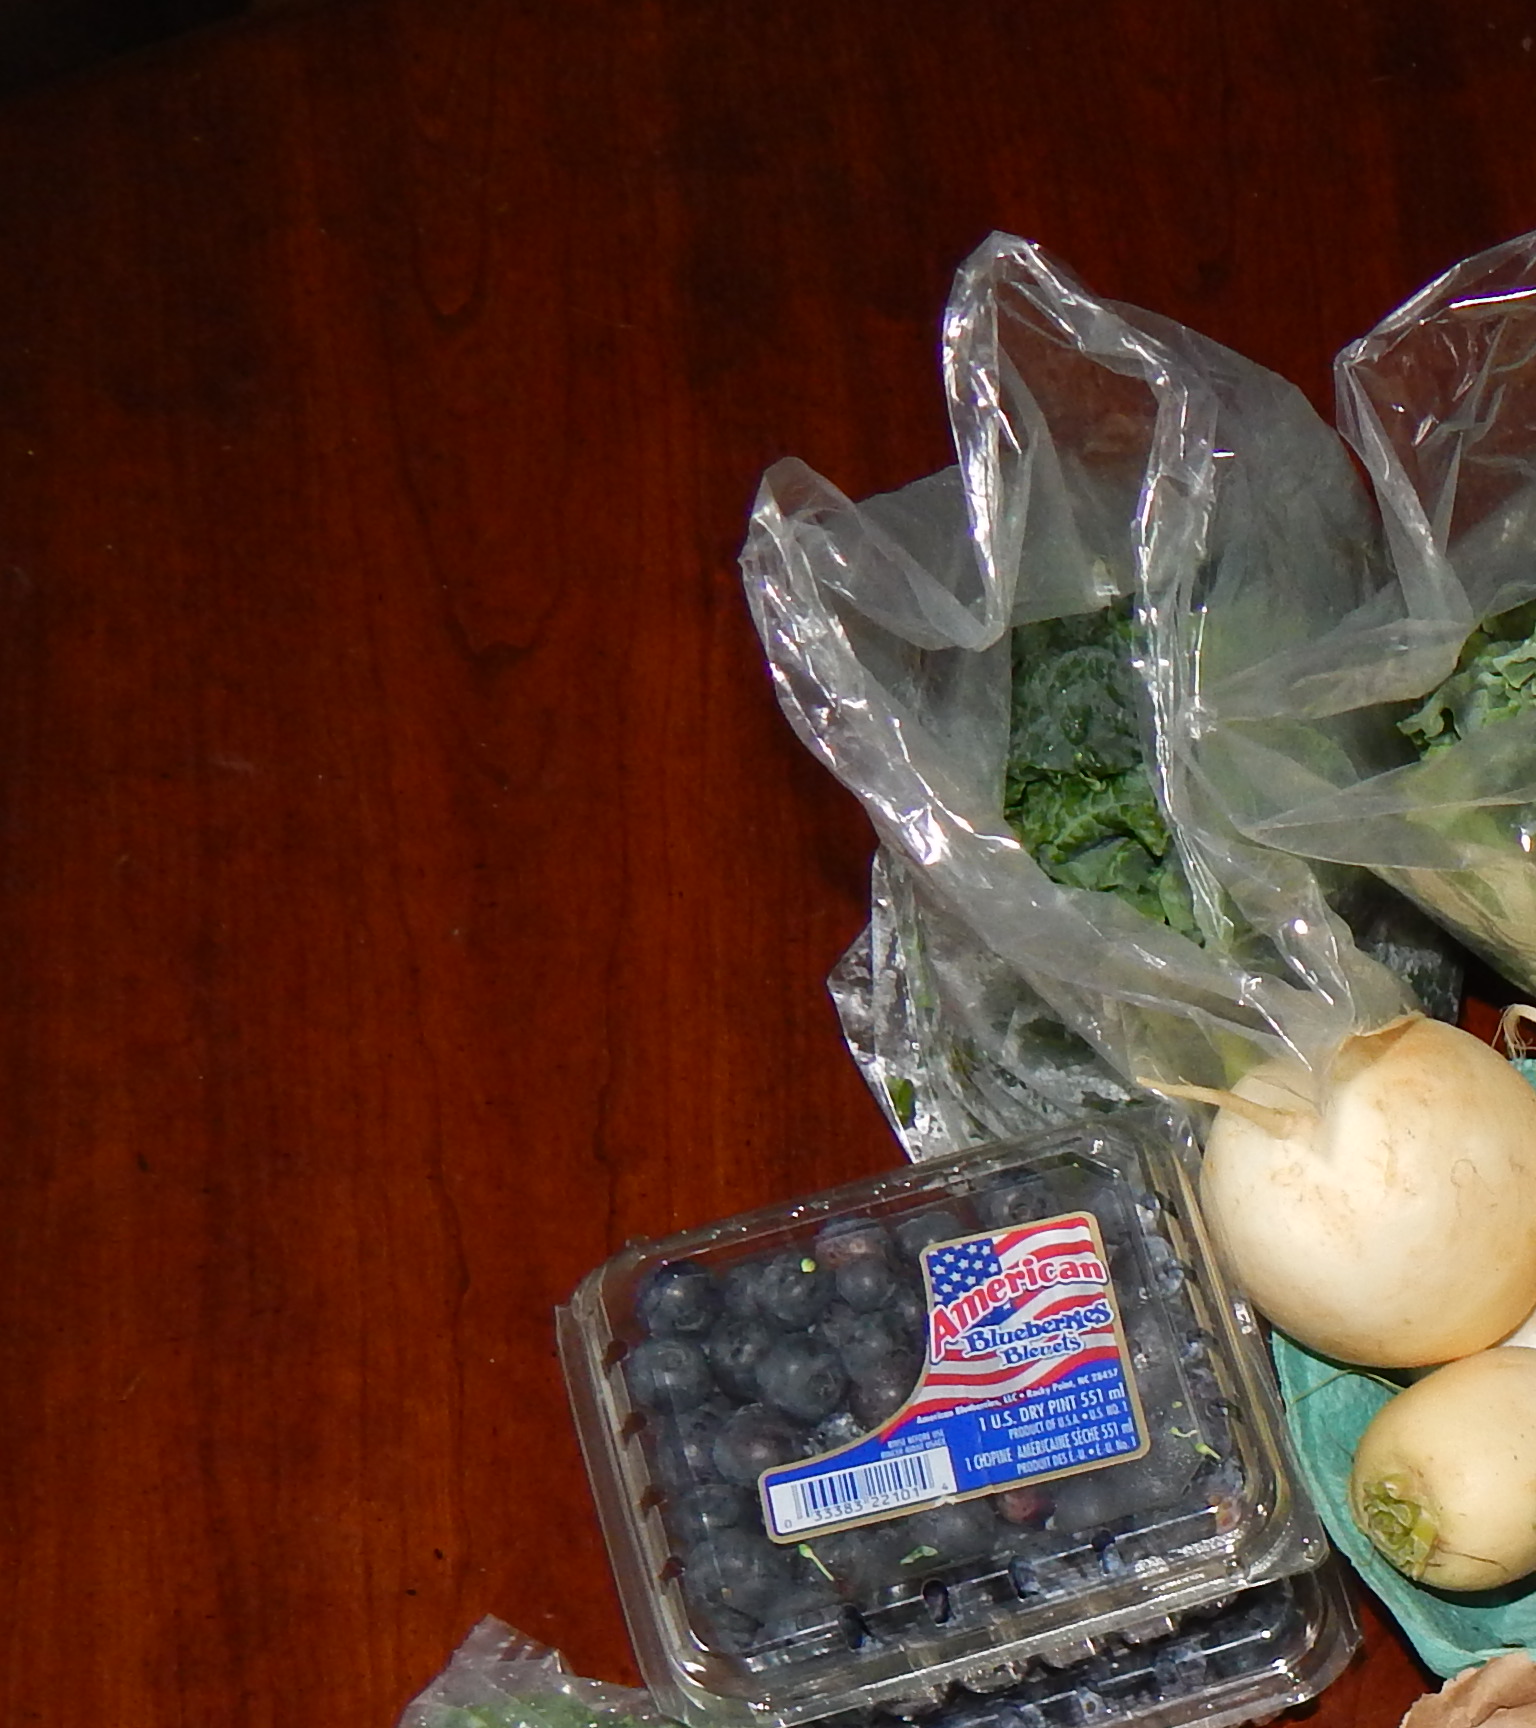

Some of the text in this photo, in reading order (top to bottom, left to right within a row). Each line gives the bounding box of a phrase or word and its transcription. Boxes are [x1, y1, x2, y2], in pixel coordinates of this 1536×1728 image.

[931, 1257, 1106, 1361] American
[962, 1301, 1113, 1355] Blueberries
[1001, 1333, 1083, 1366] Bleuets
[979, 1382, 1126, 1432] 1 U.S. DRY PINT 551 ml
[965, 1457, 973, 1473] 1
[1102, 1422, 1119, 1439] 551
[784, 1482, 950, 1530] 0 33383 22101 4
